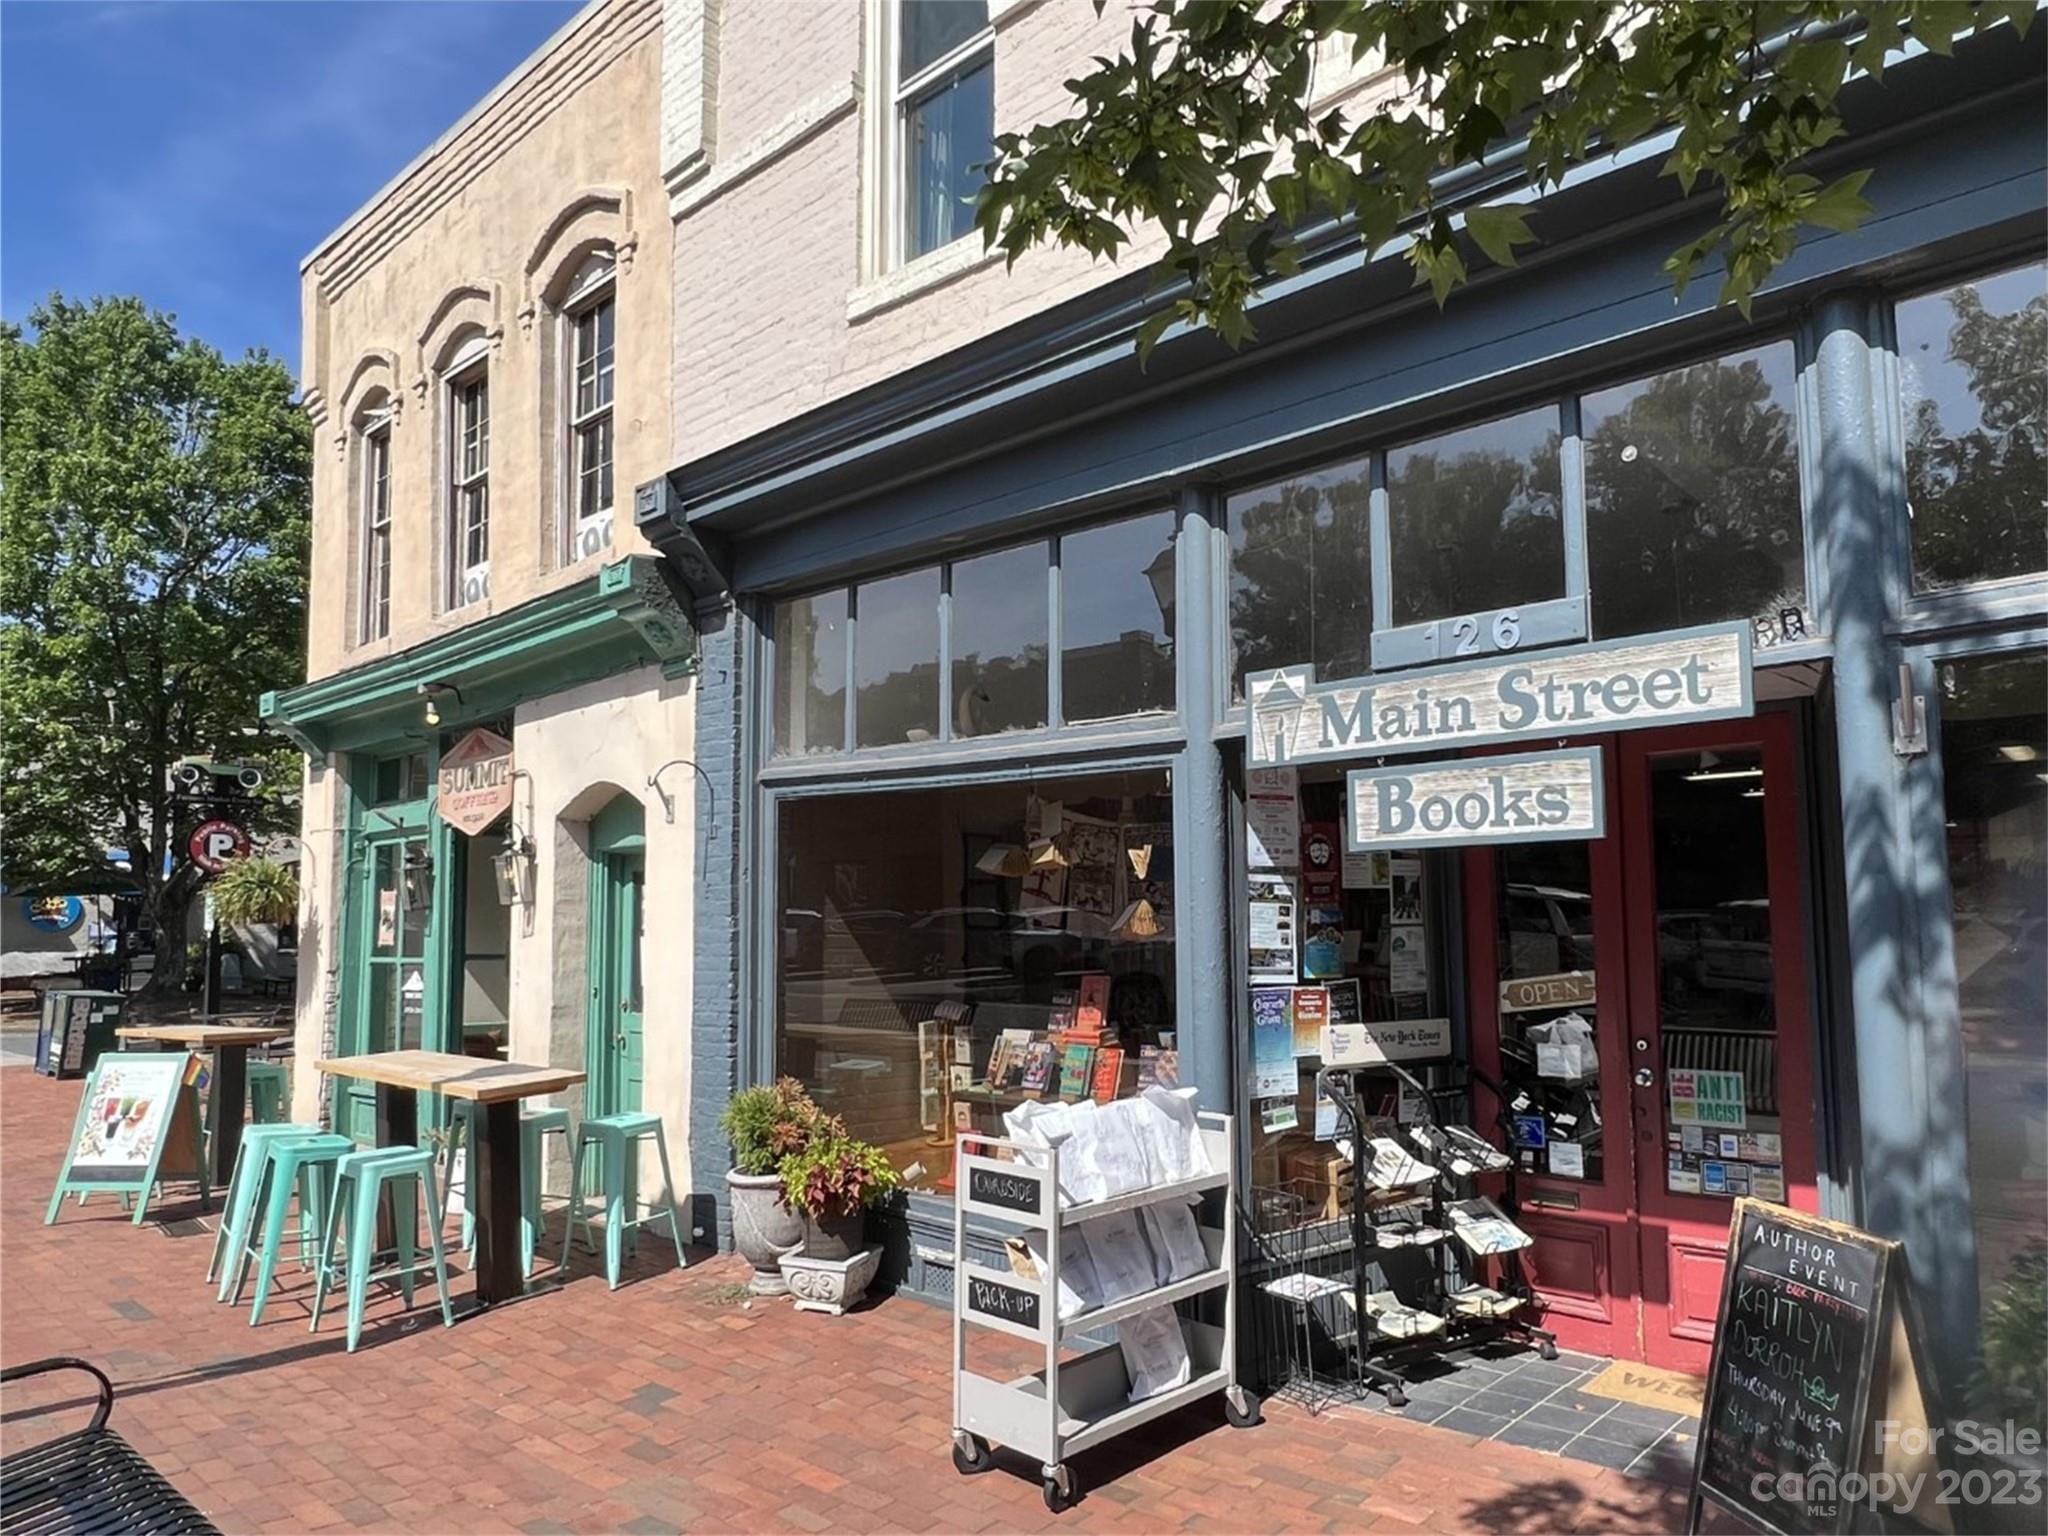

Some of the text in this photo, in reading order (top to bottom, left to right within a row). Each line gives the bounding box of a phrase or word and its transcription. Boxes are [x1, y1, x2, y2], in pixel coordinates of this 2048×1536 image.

[1422, 609, 1520, 656] 126
[1317, 653, 1713, 748] Main Street
[442, 759, 510, 796] SUMMIT
[1374, 775, 1571, 836] Books
[209, 833, 234, 859] P
[1520, 980, 1580, 1004] OPEN
[1697, 1074, 1742, 1101] ANTI
[1697, 1101, 1743, 1124] RACIST
[1753, 1223, 1837, 1268] AUTHOR
[975, 1281, 1035, 1312] PICK-UP
[1788, 1258, 1860, 1299] EVENT
[1736, 1281, 1846, 1374] KAITLYN
